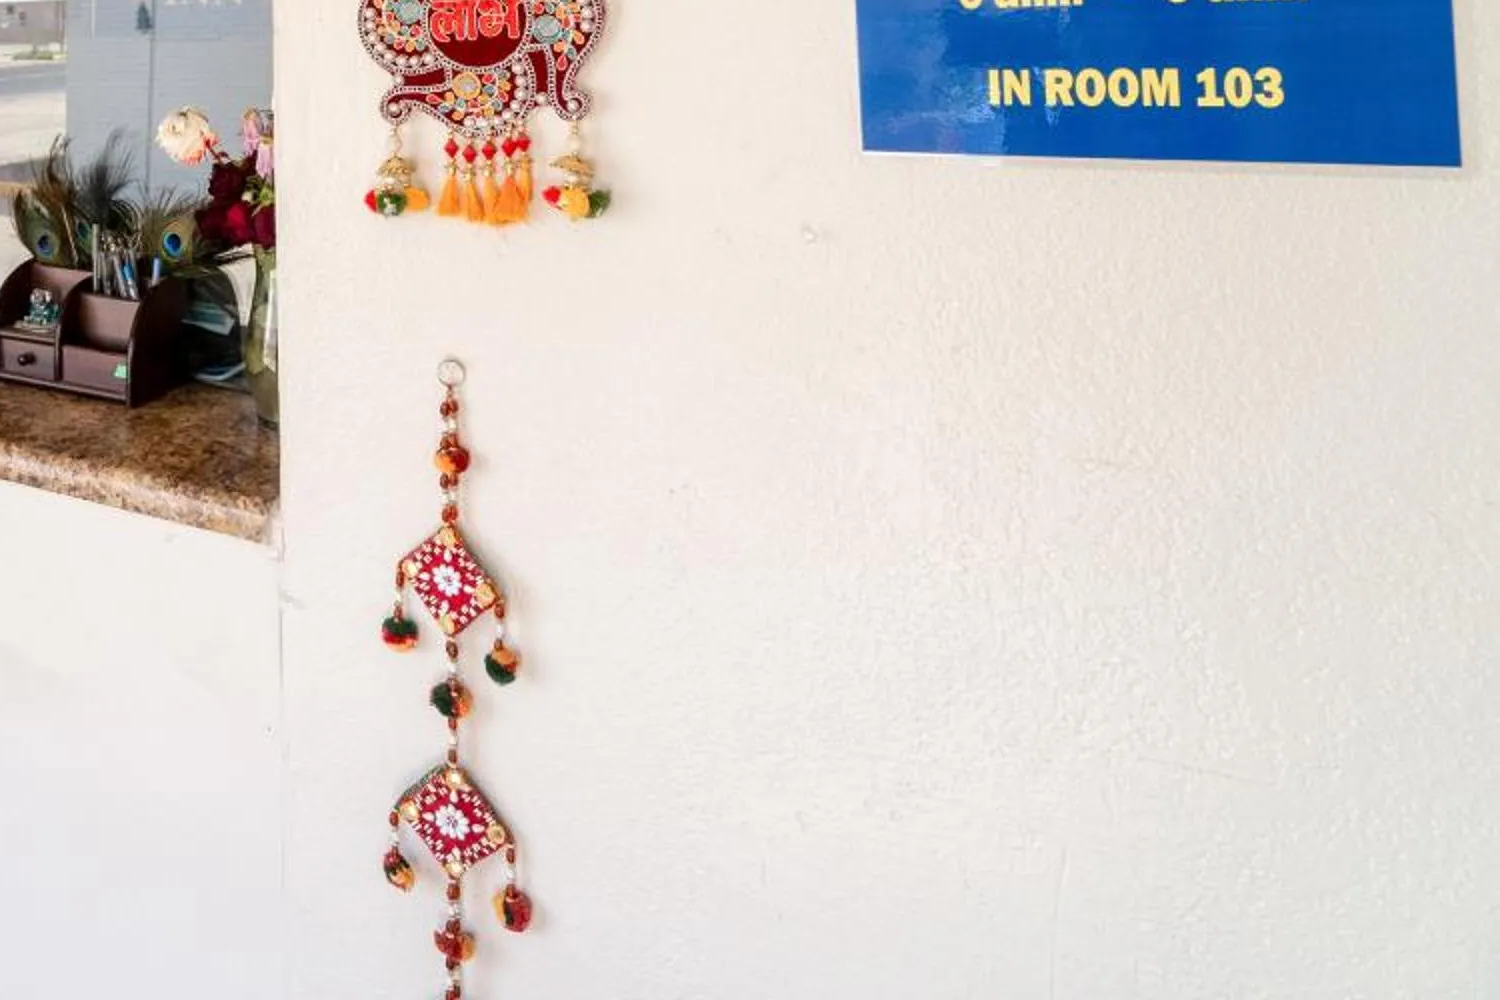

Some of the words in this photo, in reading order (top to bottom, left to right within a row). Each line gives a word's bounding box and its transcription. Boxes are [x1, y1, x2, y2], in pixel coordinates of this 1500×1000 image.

[988, 69, 1031, 107] IN
[1044, 68, 1180, 108] ROOM
[1196, 67, 1285, 108] 103
